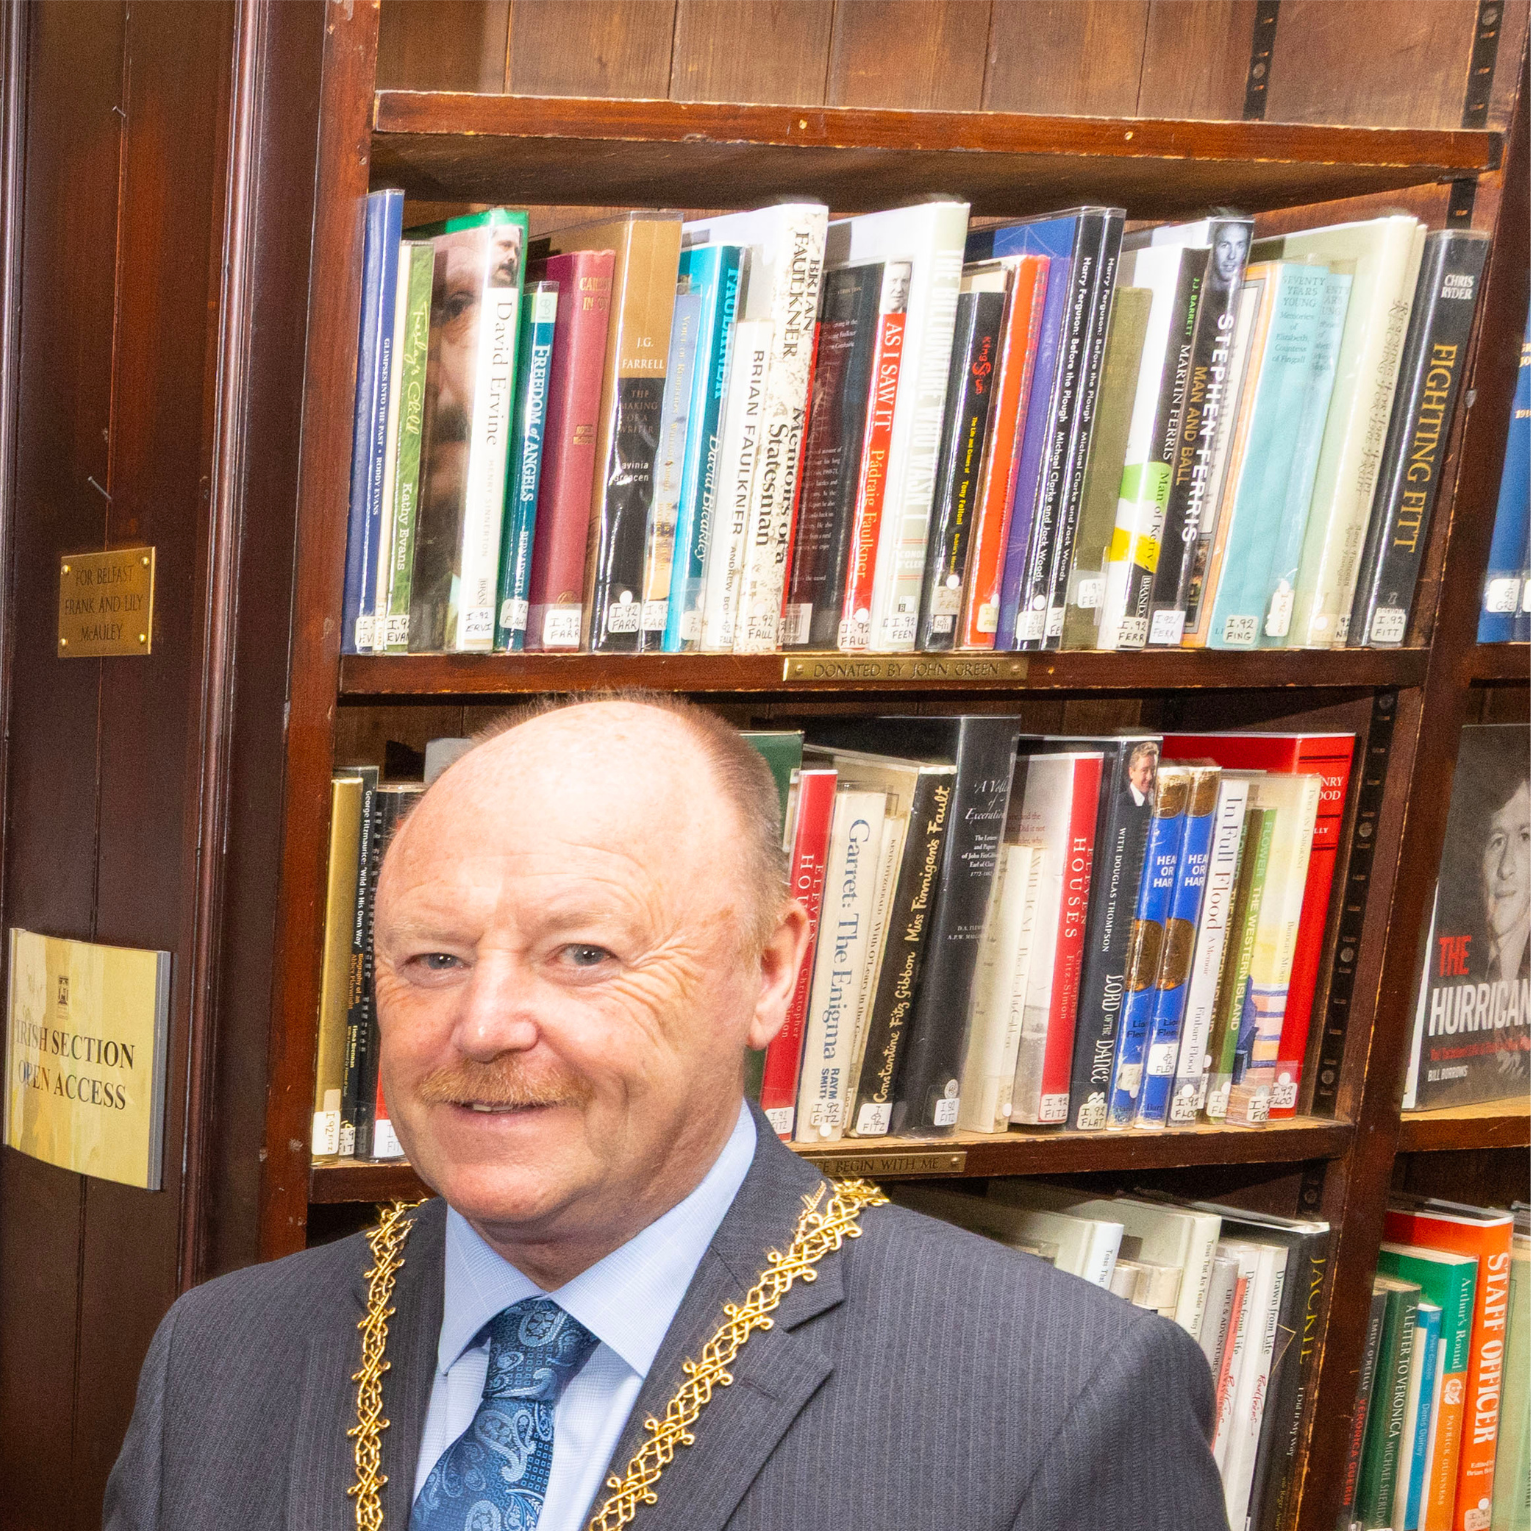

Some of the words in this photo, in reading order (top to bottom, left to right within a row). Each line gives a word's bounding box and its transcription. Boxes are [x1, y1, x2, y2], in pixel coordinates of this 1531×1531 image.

[782, 231, 811, 359] FAULKNER
[802, 258, 822, 332] BRIAN
[1282, 274, 1327, 287] SEVENTY
[1282, 296, 1317, 308] YOUNG
[1287, 285, 1318, 297] YEARS
[1441, 286, 1473, 300] RYDER
[1444, 274, 1475, 287] CHRIS
[489, 300, 514, 368] David
[621, 357, 665, 370] FARRELL
[885, 320, 902, 347] AS
[532, 343, 552, 417] FREEDOM
[747, 349, 766, 417] BRIAN
[877, 365, 894, 410] SAW
[1172, 344, 1191, 404] MARTIN
[1190, 367, 1210, 402] MAN
[1200, 314, 1234, 436] STEPHEN
[486, 375, 511, 446] Ervine
[1163, 408, 1182, 462] FERRIS
[1185, 405, 1198, 442] AND
[1406, 343, 1458, 484] FIGHTING
[520, 441, 542, 502] ANGELS
[732, 423, 755, 535] FAULKNER
[755, 423, 789, 548] Statesman
[778, 406, 805, 517] Memoirs
[864, 447, 885, 510] Pádraig
[1182, 442, 1207, 543] FERRIS
[1394, 491, 1427, 553] FITT
[75, 569, 93, 586] FOR
[97, 565, 134, 585] BELFAST
[856, 512, 878, 579] Faulkner
[65, 597, 95, 615] FRANK
[99, 596, 121, 613] AND
[125, 594, 143, 611] LILY
[813, 662, 882, 678] DONATED
[887, 663, 905, 677] BY
[910, 662, 949, 677] JOHN
[954, 661, 999, 676] GREEN
[841, 819, 871, 910] Garret:
[1205, 865, 1231, 931] Flood
[833, 914, 861, 964] The
[1439, 934, 1471, 977] THE
[822, 966, 853, 1061] Enigma
[15, 1019, 47, 1051] IRISH
[51, 1029, 135, 1070] SECTION
[18, 1059, 51, 1091] OPEN
[54, 1073, 126, 1110] ACCESS
[836, 1158, 880, 1172] BEGIN
[885, 1157, 917, 1172] WITH
[920, 1157, 939, 1171] ME
[1300, 1257, 1326, 1365] JACKIE
[1483, 1253, 1509, 1332] STAFF
[1474, 1339, 1502, 1445] OFFICER
